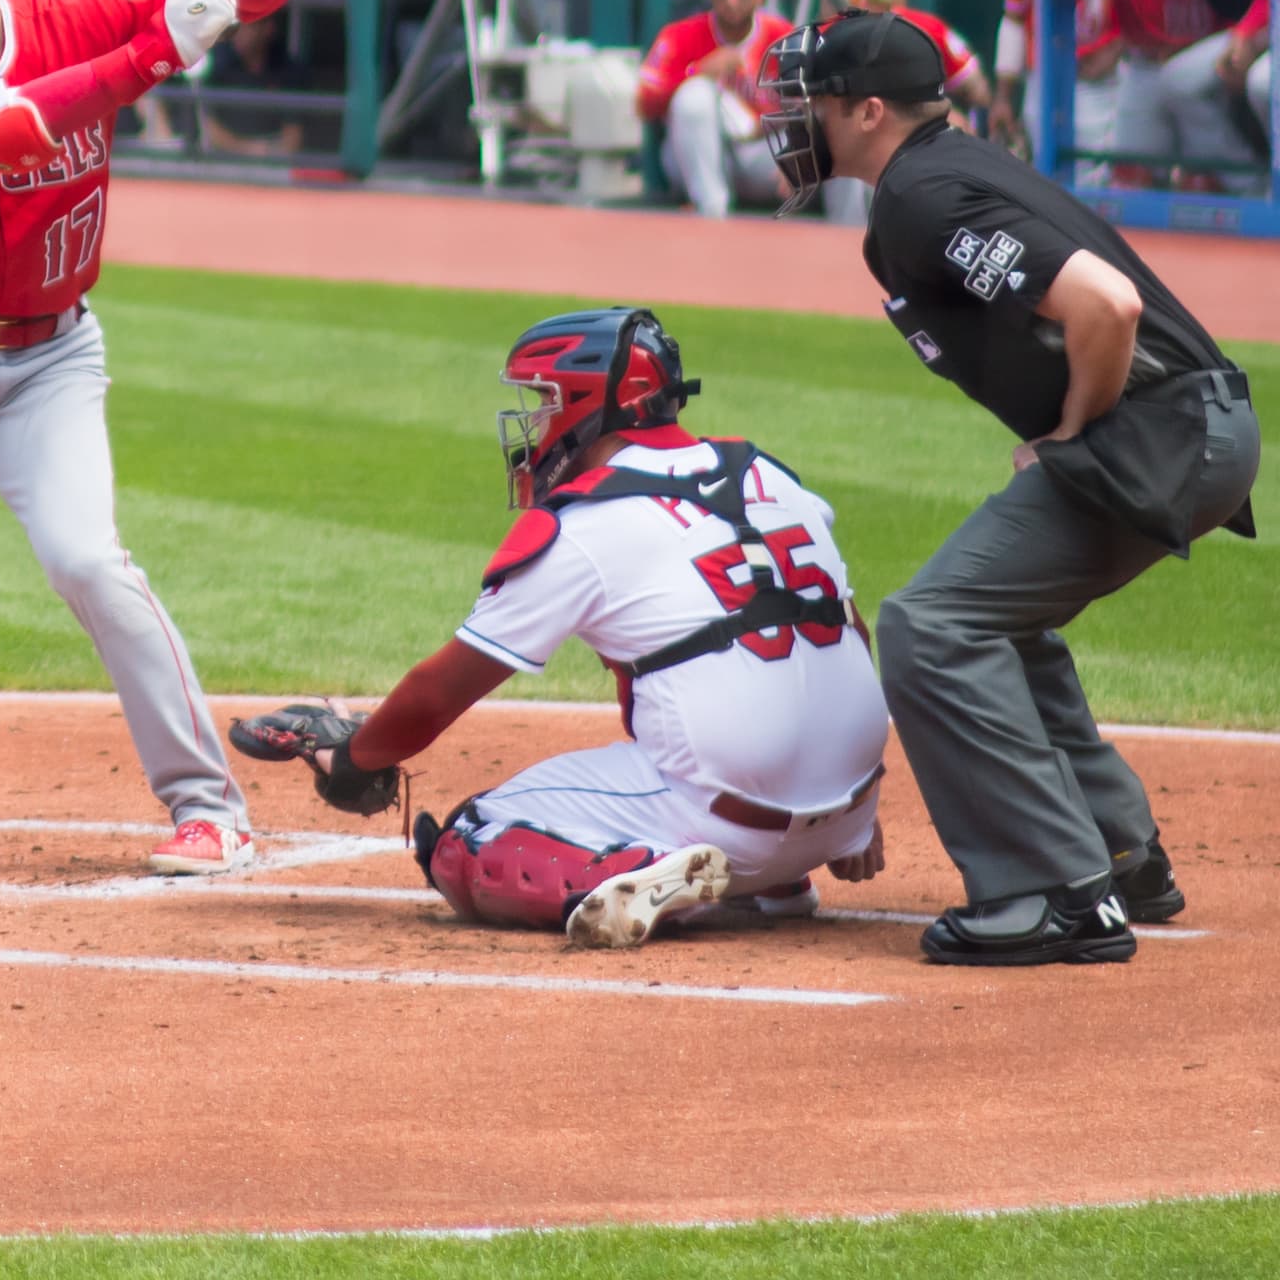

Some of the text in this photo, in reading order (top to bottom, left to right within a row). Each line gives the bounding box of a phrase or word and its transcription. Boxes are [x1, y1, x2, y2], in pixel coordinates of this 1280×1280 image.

[42, 185, 103, 288] 17
[953, 235, 980, 264] DR
[972, 236, 1017, 293] DH BE
[691, 523, 844, 662] 55
[1097, 895, 1126, 928] N
